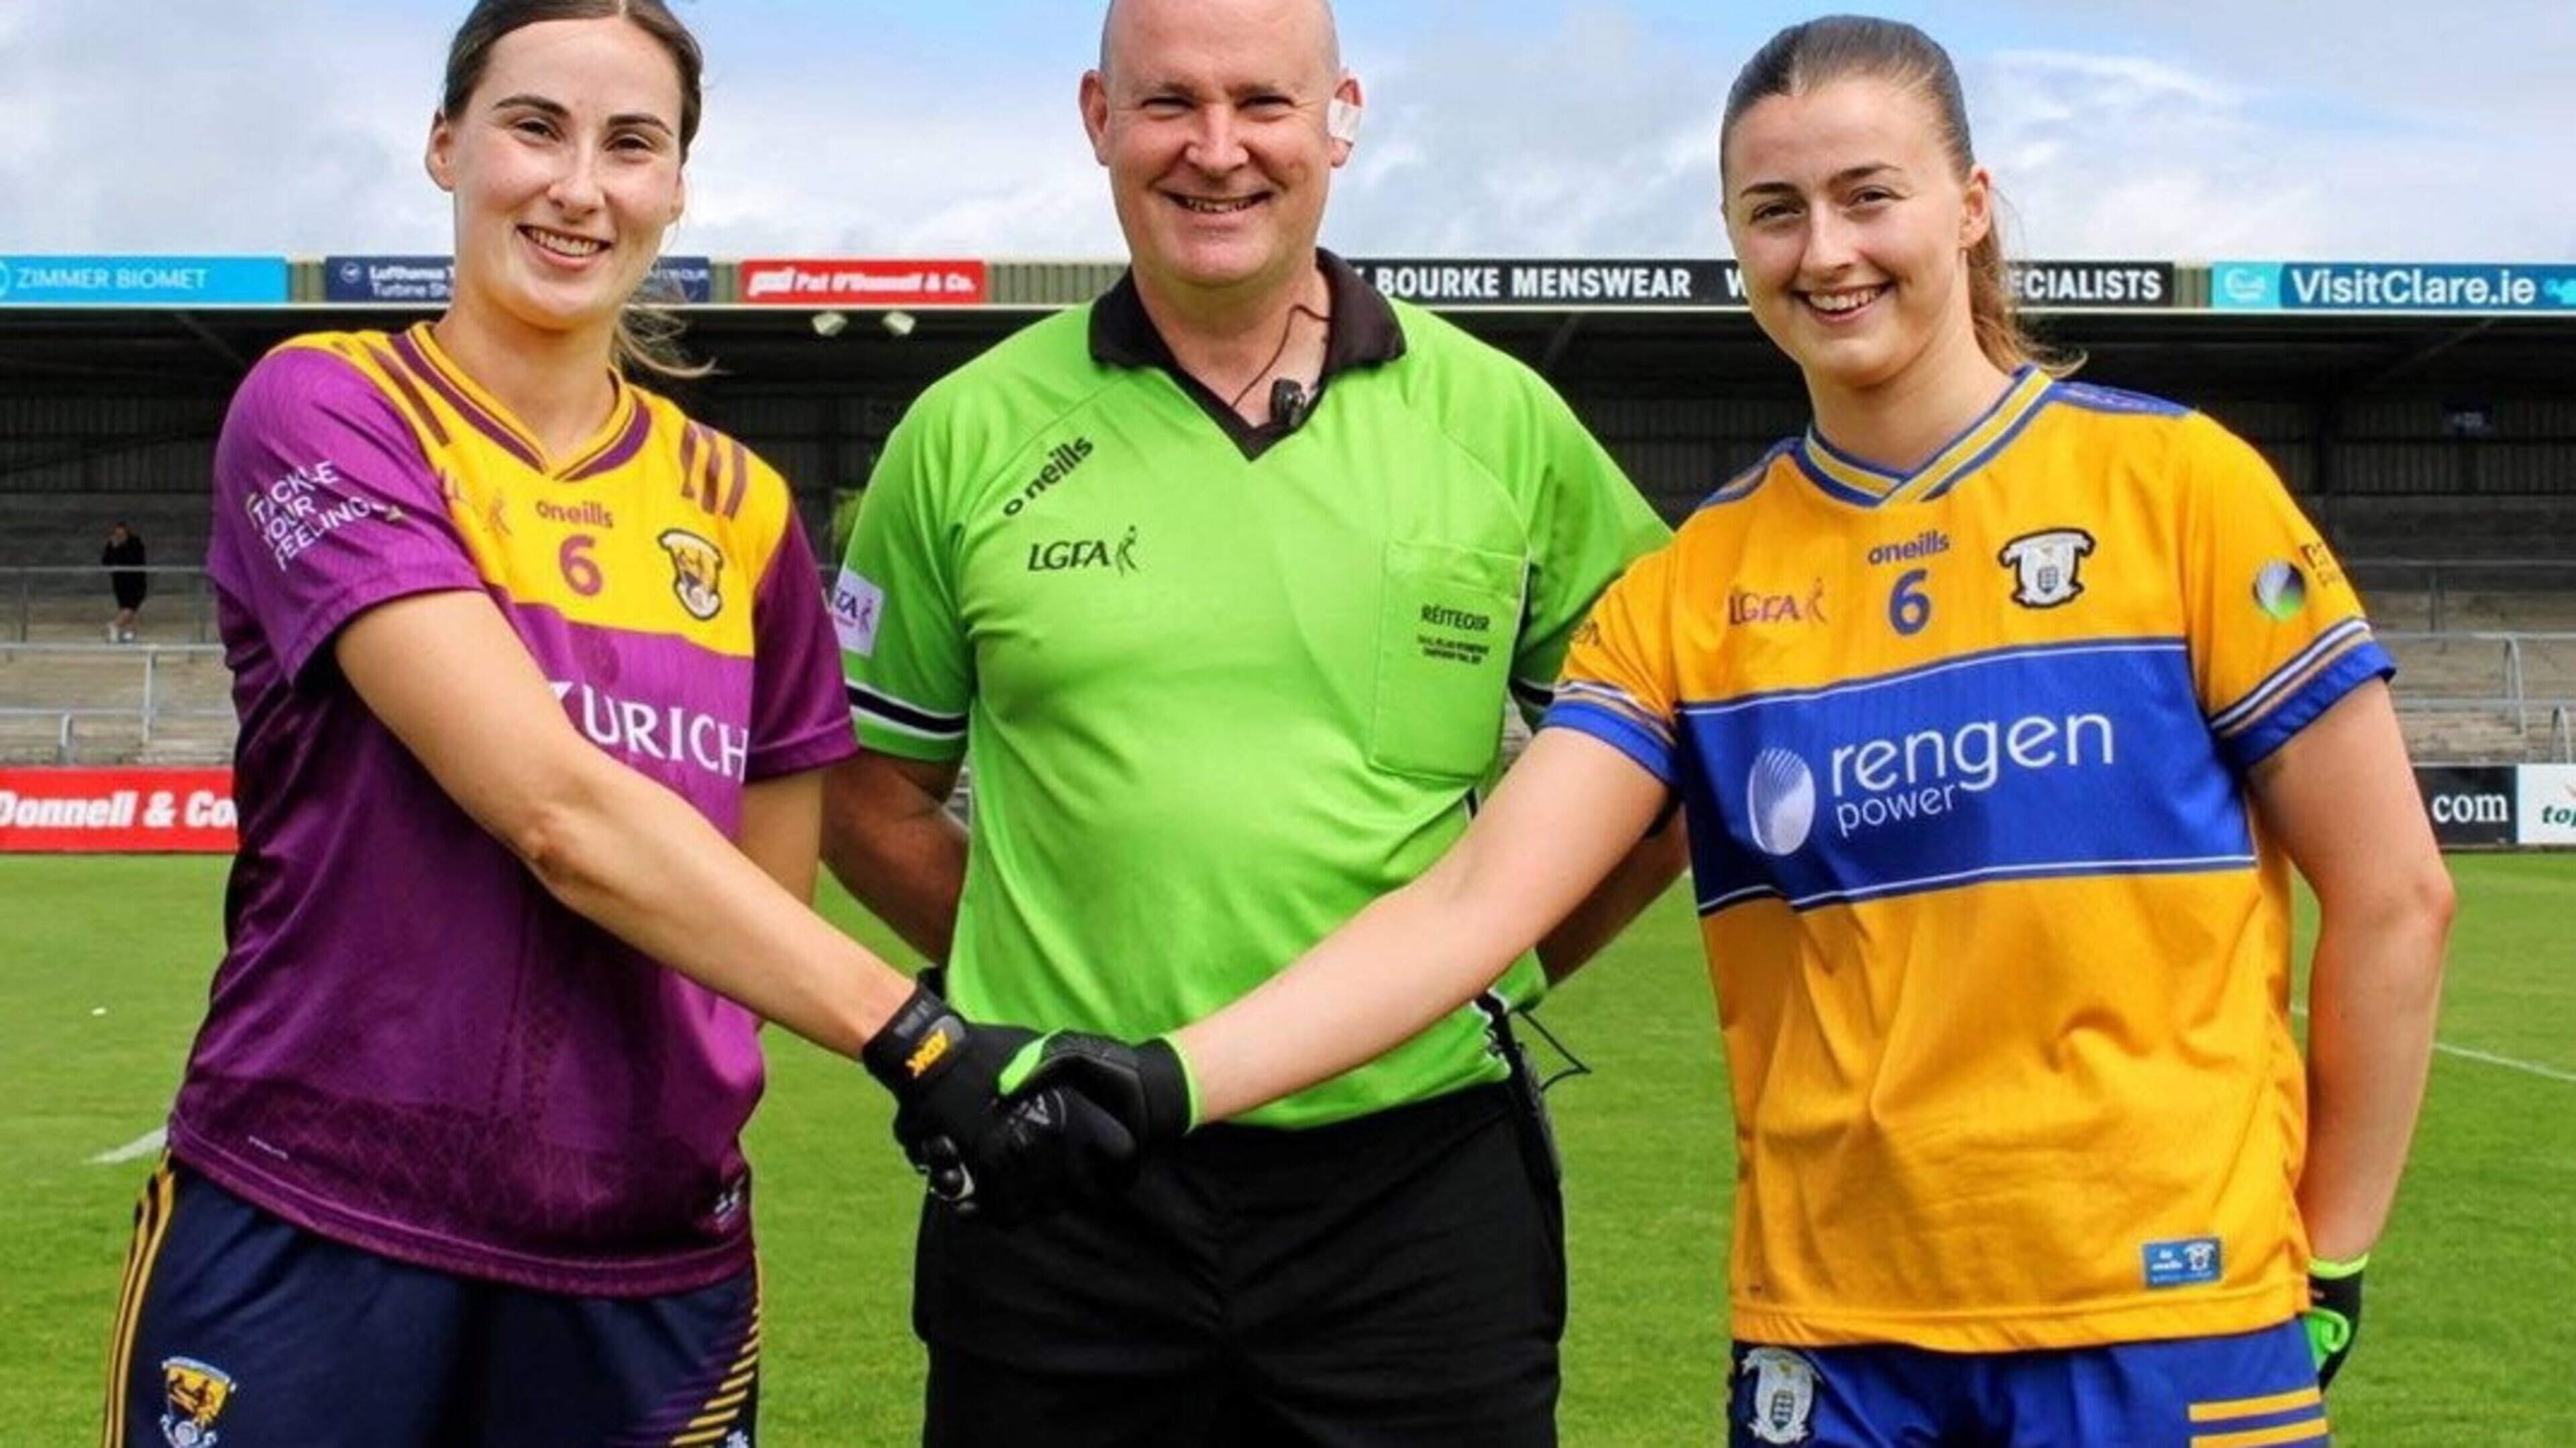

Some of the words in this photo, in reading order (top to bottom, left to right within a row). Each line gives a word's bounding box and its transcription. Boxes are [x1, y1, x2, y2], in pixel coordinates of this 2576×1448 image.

[16, 268, 109, 289] ZIMMER
[116, 268, 207, 289] BIOMET
[1376, 266, 1500, 297] BOURKE
[1511, 267, 1692, 297] MENSWEAR
[2003, 268, 2161, 299] ECIALISTS
[2292, 268, 2536, 304] VisitClare.ie
[535, 499, 614, 529] oneills
[559, 534, 602, 596] 6
[1868, 529, 1950, 565] oneills
[1888, 568, 1931, 635] 6
[1832, 713, 2113, 796] rengen
[143, 790, 176, 828] &
[1837, 783, 1956, 838] power
[2432, 794, 2509, 824] com
